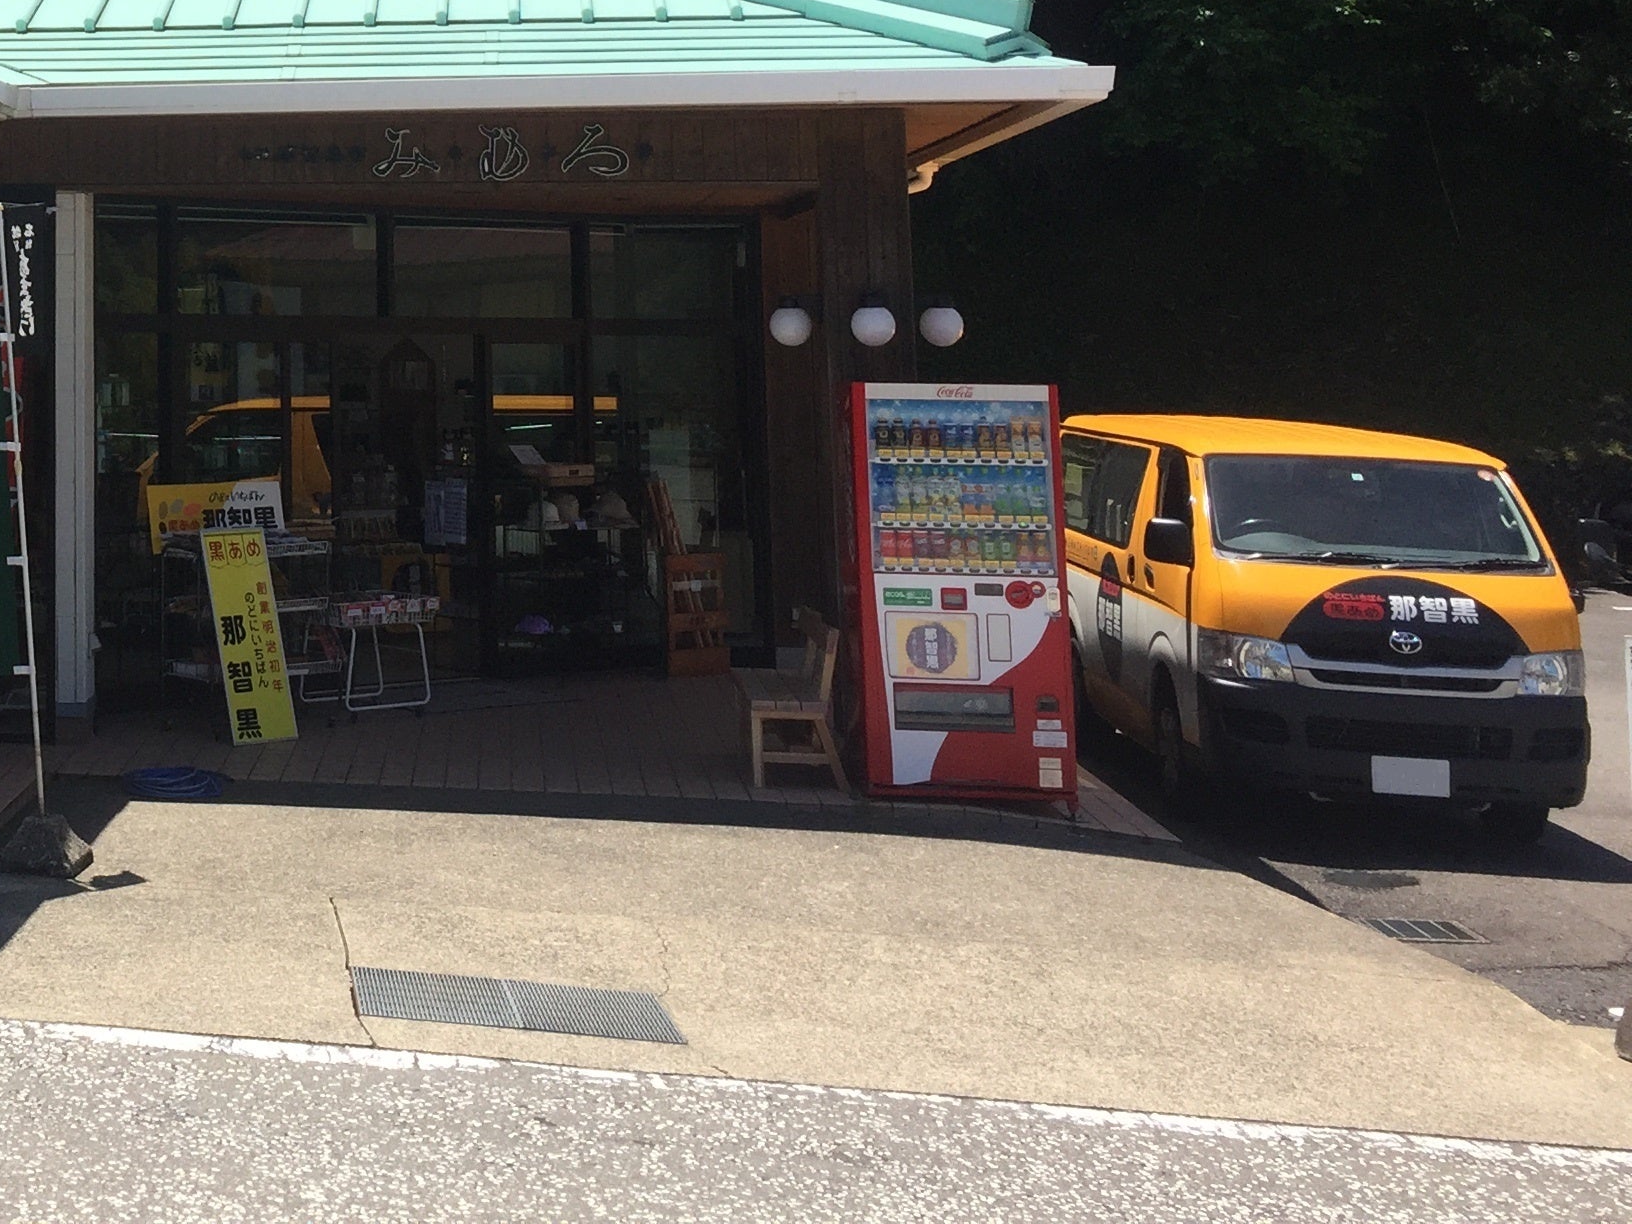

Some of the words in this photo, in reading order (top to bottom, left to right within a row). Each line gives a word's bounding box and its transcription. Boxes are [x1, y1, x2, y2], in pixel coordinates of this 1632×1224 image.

[208, 537, 261, 562] 黒あめ
[244, 592, 270, 689] のどにいちばん
[1388, 595, 1480, 625] 那智黒
[220, 614, 263, 740] 那智黒
